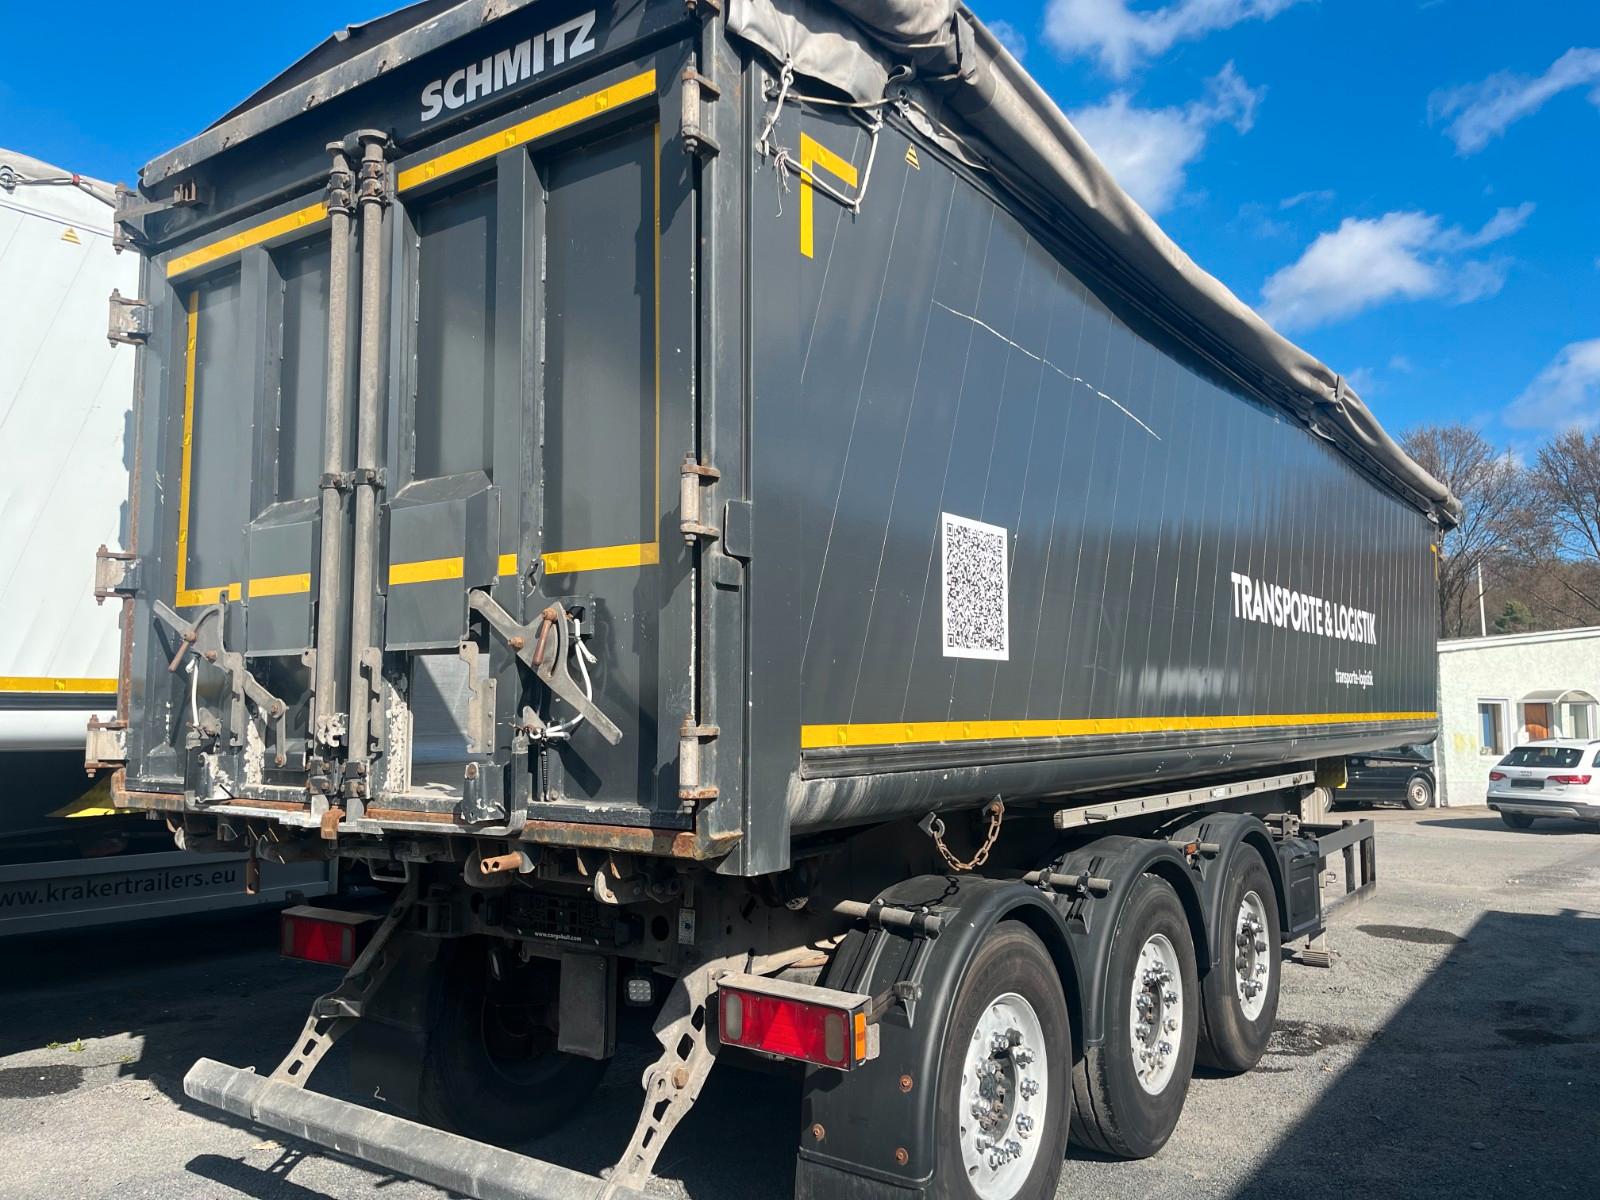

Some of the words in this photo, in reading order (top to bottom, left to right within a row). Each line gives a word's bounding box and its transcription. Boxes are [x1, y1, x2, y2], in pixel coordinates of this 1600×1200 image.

[420, 9, 596, 122] SCHMITZ
[1231, 571, 1324, 635] TRANSPORTE
[1325, 600, 1333, 638] &
[1334, 602, 1377, 645] LOGISTIK
[1335, 667, 1373, 690] transporte-logistik
